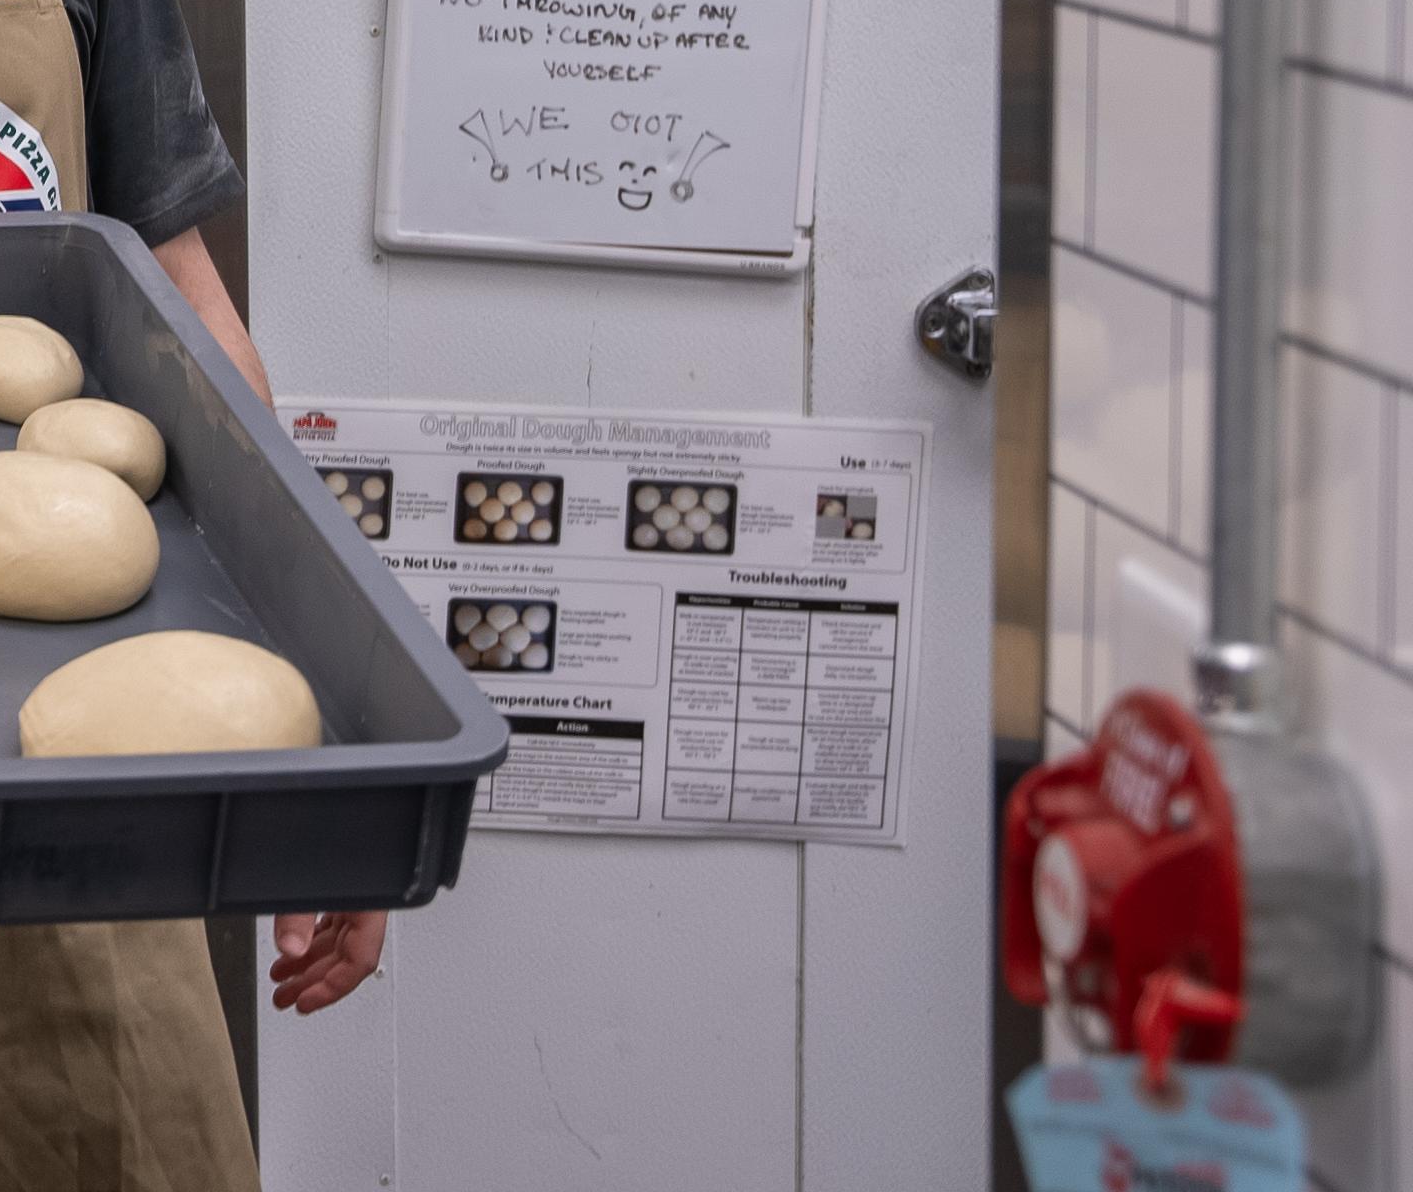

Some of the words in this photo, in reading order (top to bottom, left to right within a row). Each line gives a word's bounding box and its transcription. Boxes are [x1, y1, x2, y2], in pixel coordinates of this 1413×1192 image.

[651, 4, 686, 20] OF
[698, 4, 736, 28] ANY
[478, 24, 533, 45] KIND
[559, 27, 635, 48] CLEAN
[637, 33, 669, 49] UP
[675, 32, 749, 50] AFTER
[543, 59, 662, 81] YOURSELF
[499, 106, 569, 135] WE
[0, 122, 50, 185] PIZZA
[527, 158, 604, 185] THIS
[420, 414, 517, 441] Original
[523, 418, 602, 445] Dough
[608, 421, 771, 449] Management
[322, 453, 357, 464] Proofed
[359, 454, 390, 466] Dough
[477, 460, 512, 470] Proofed
[514, 461, 545, 472] Dough
[840, 456, 866, 469] Use
[626, 465, 658, 476] Slightly
[659, 467, 713, 480] Overproofed
[715, 469, 744, 480] Dough
[381, 556, 400, 568] Do
[403, 557, 428, 569] Not
[433, 558, 457, 570] Use
[502, 564, 509, 572] or
[512, 563, 517, 572] if
[532, 564, 553, 574] days)
[449, 583, 468, 593] Very
[470, 584, 527, 594] Overproofed
[529, 586, 559, 596] Dough
[729, 570, 847, 591] Troubleshooting
[484, 692, 569, 708] emperature
[573, 696, 612, 710] Chart
[557, 721, 589, 733] Action
